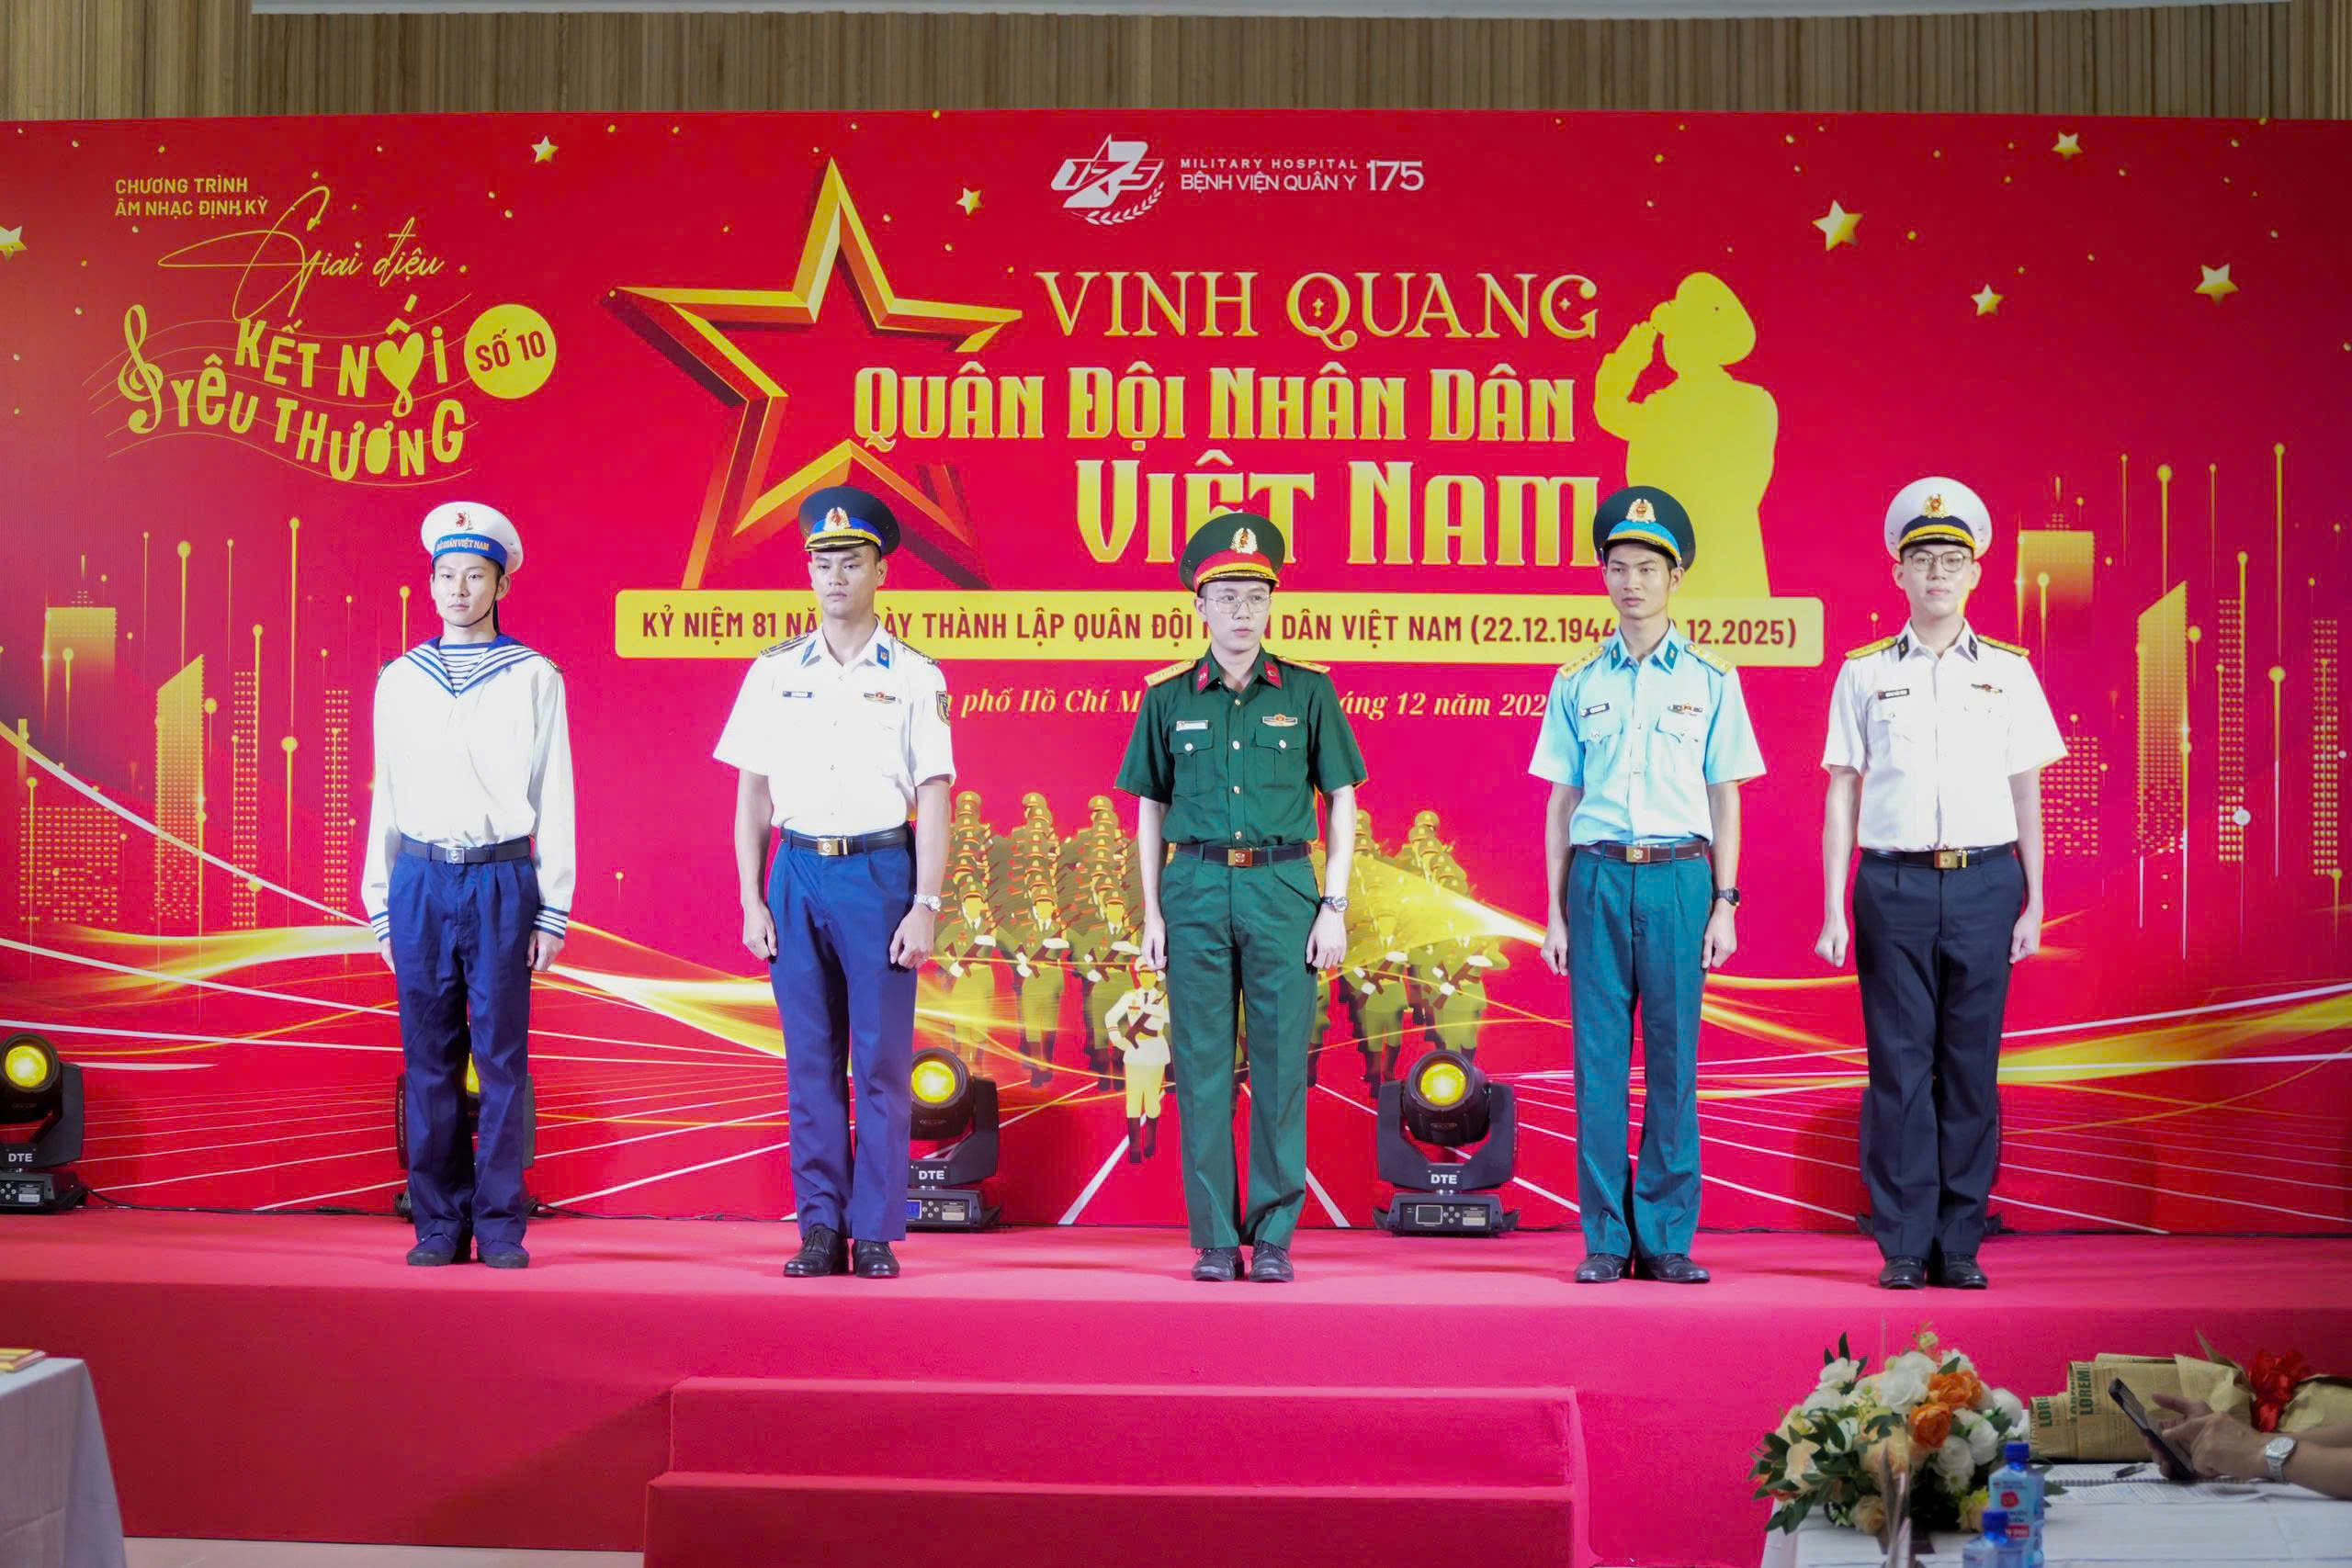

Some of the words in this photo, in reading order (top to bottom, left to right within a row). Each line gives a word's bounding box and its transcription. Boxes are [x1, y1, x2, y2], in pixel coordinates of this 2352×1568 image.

[1181, 159, 1263, 169] MILITARY
[1272, 159, 1359, 170] HOSPITAL
[1181, 172, 1233, 194] BỆNH
[1237, 172, 1282, 194] VIỆN
[1283, 172, 1335, 191] QUÂN
[1341, 175, 1357, 191] Y
[1366, 161, 1424, 191] 175
[116, 177, 188, 194] CHƯƠNG
[194, 175, 248, 193] TRÌNH
[115, 198, 141, 217] ÂM
[145, 200, 194, 219] NHẠC
[198, 199, 242, 218] ĐỊNH
[245, 196, 269, 215] KỲ
[372, 217, 445, 287] điệu
[1035, 272, 1258, 338] VINH
[1288, 272, 1600, 352] QUANG
[235, 318, 320, 387] KẾT
[475, 328, 511, 372] SỐ
[516, 331, 547, 360] 10
[274, 399, 465, 482] THƯƠNG
[643, 604, 674, 637] KỶ
[684, 606, 743, 646] NIỆM
[752, 612, 776, 637] 81
[786, 606, 818, 637] NĂ
[922, 606, 1006, 639] THÀNH
[1017, 607, 1065, 648] LẬP
[1074, 607, 1140, 642] QUÂN
[1152, 607, 1192, 648] ĐỘI
[1282, 609, 1331, 640] DÂN
[1341, 609, 1398, 649] VIỆT
[1408, 615, 1461, 641] NAM
[961, 687, 1014, 718] phố
[1020, 689, 1056, 713] Hồ
[1065, 690, 1111, 713] Chí
[1340, 692, 1388, 720] áng
[1397, 692, 1425, 716] 12
[1433, 693, 1490, 716] năm
[1498, 694, 1547, 716] 202
[8, 1153, 33, 1162] DTE
[919, 1170, 945, 1180] DTE
[1430, 1174, 1457, 1184] DTE
[2076, 1370, 2094, 1415] LOREM
